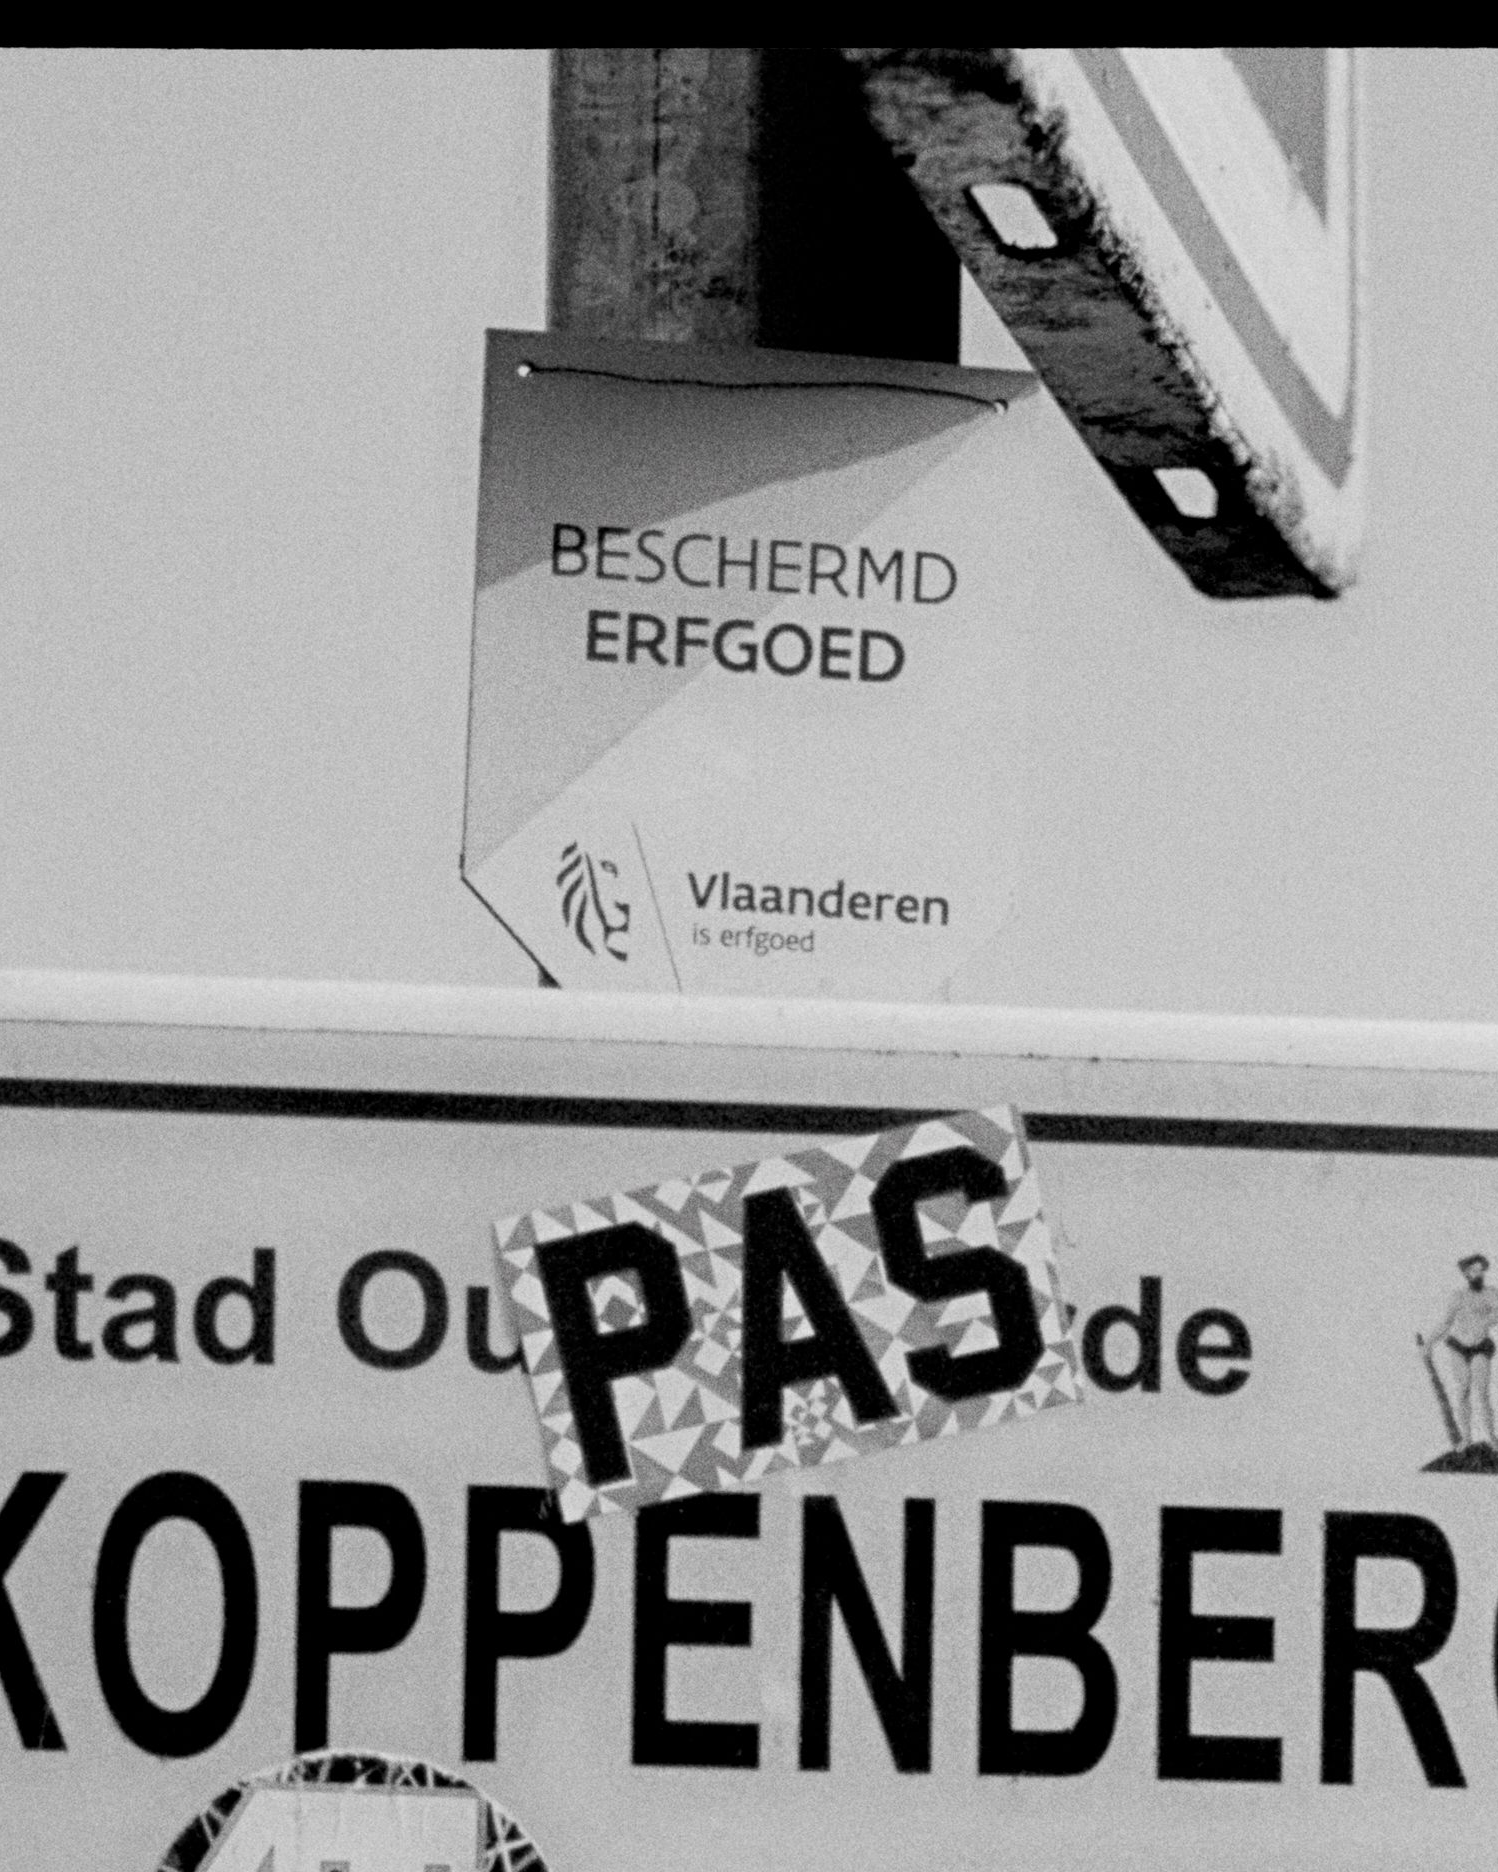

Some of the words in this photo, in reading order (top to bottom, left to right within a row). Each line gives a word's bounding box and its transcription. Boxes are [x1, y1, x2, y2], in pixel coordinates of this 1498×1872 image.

[550, 523, 958, 605] BESCHERMD
[585, 609, 906, 684] ERFGOED
[687, 870, 951, 927] Vlaanderen
[691, 922, 711, 946] is
[719, 924, 816, 956] erfgoed
[535, 1143, 1047, 1490] PAS
